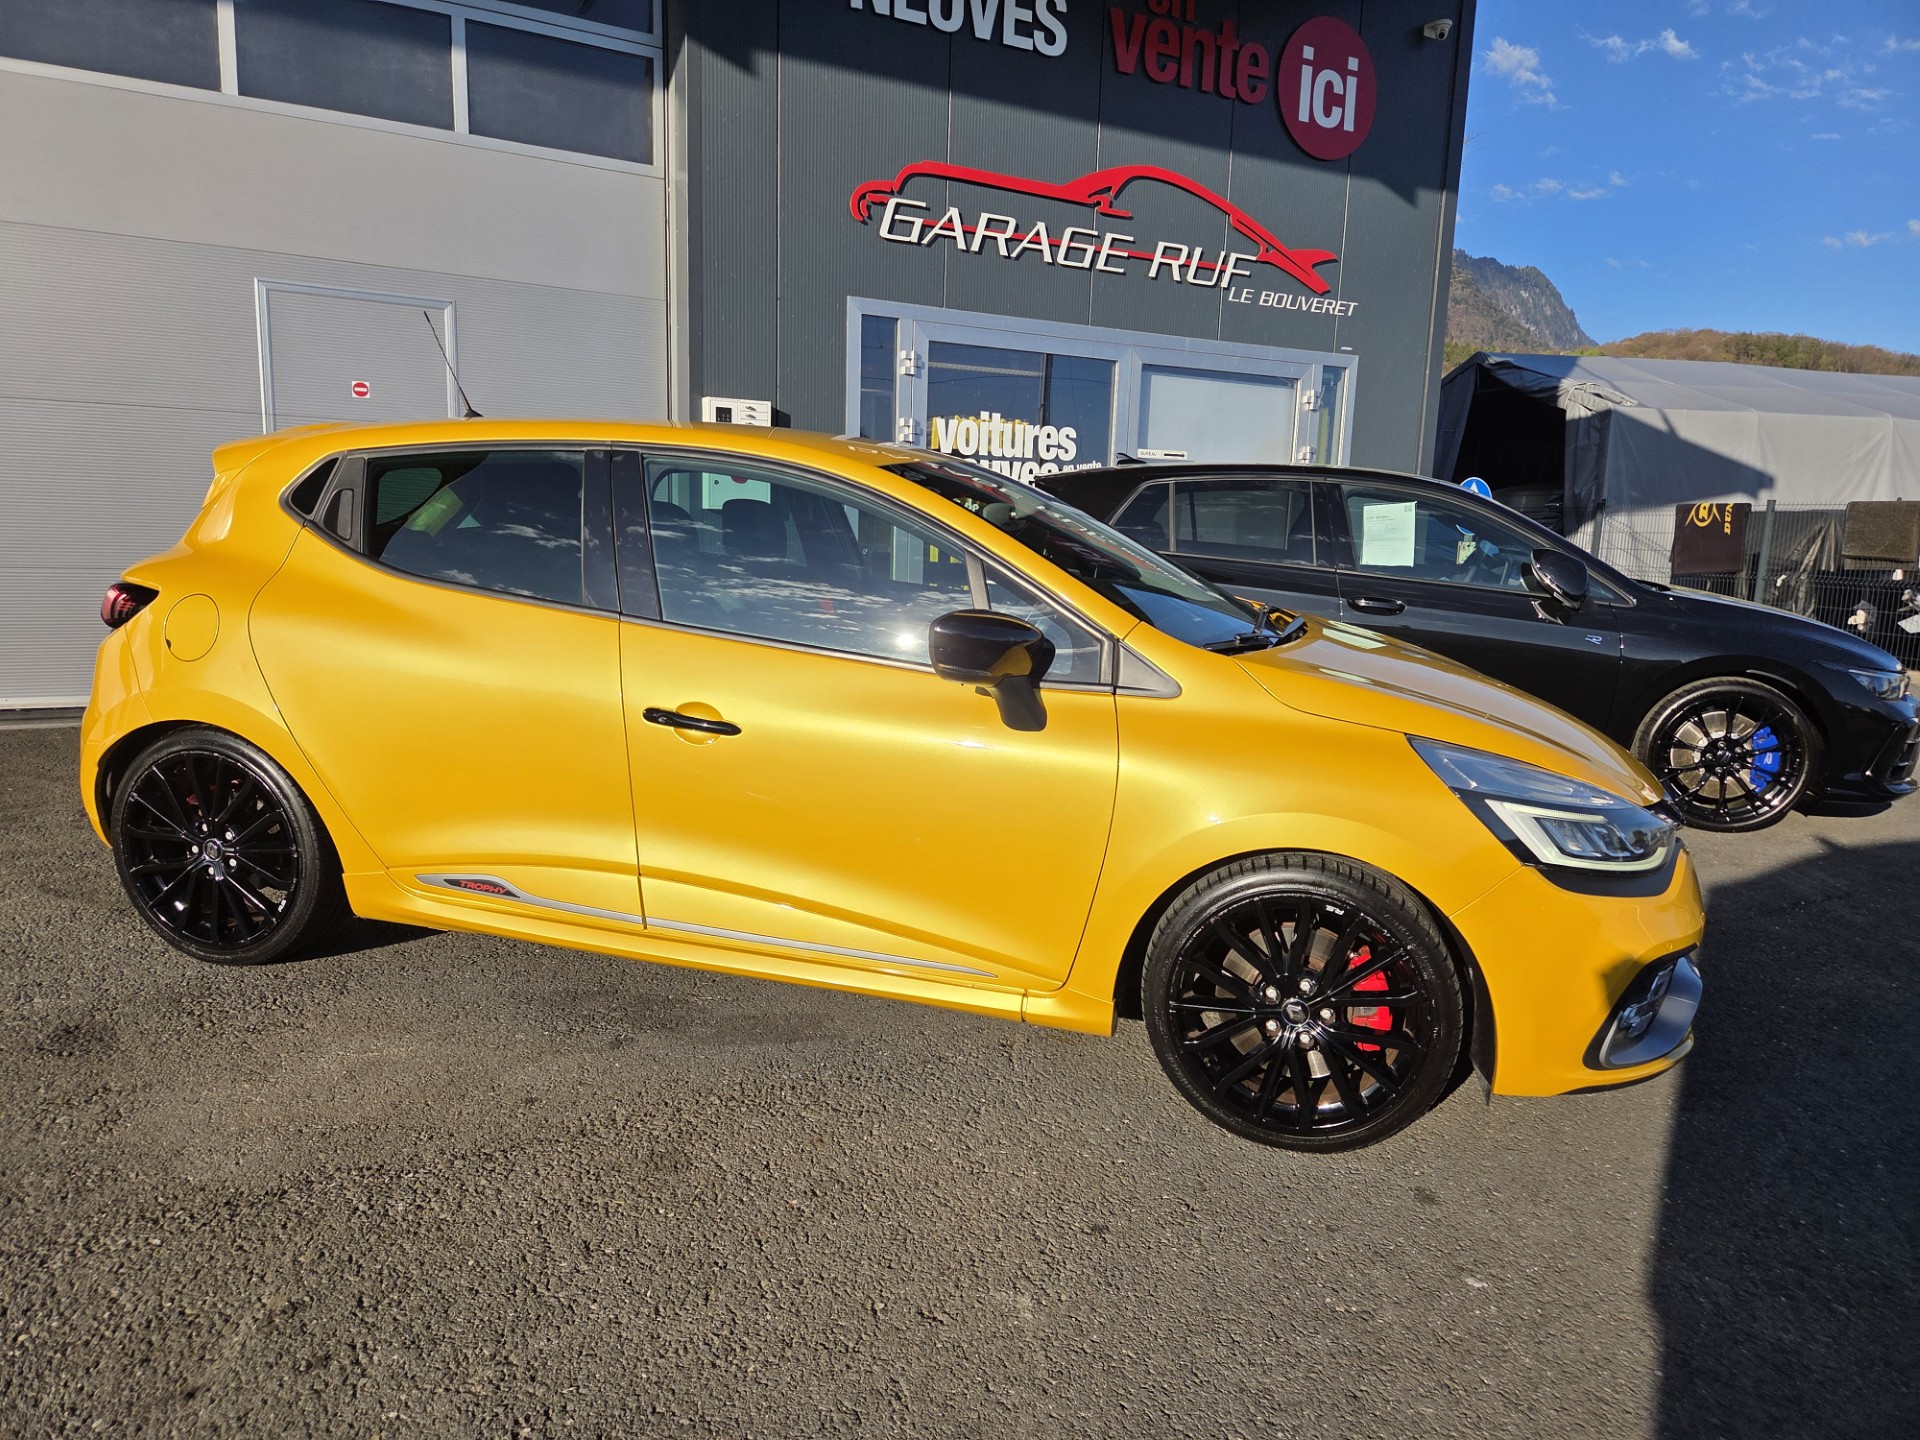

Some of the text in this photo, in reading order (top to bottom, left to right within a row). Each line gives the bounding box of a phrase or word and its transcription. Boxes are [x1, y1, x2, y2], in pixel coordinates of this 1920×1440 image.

[1110, 7, 1270, 104] vente
[1298, 45, 1360, 132] ici
[879, 197, 1257, 288] GARAGE RUF
[1228, 286, 1358, 316] LE BOUVERET
[936, 410, 1077, 461] voitures
[460, 880, 508, 894] TROPHY
